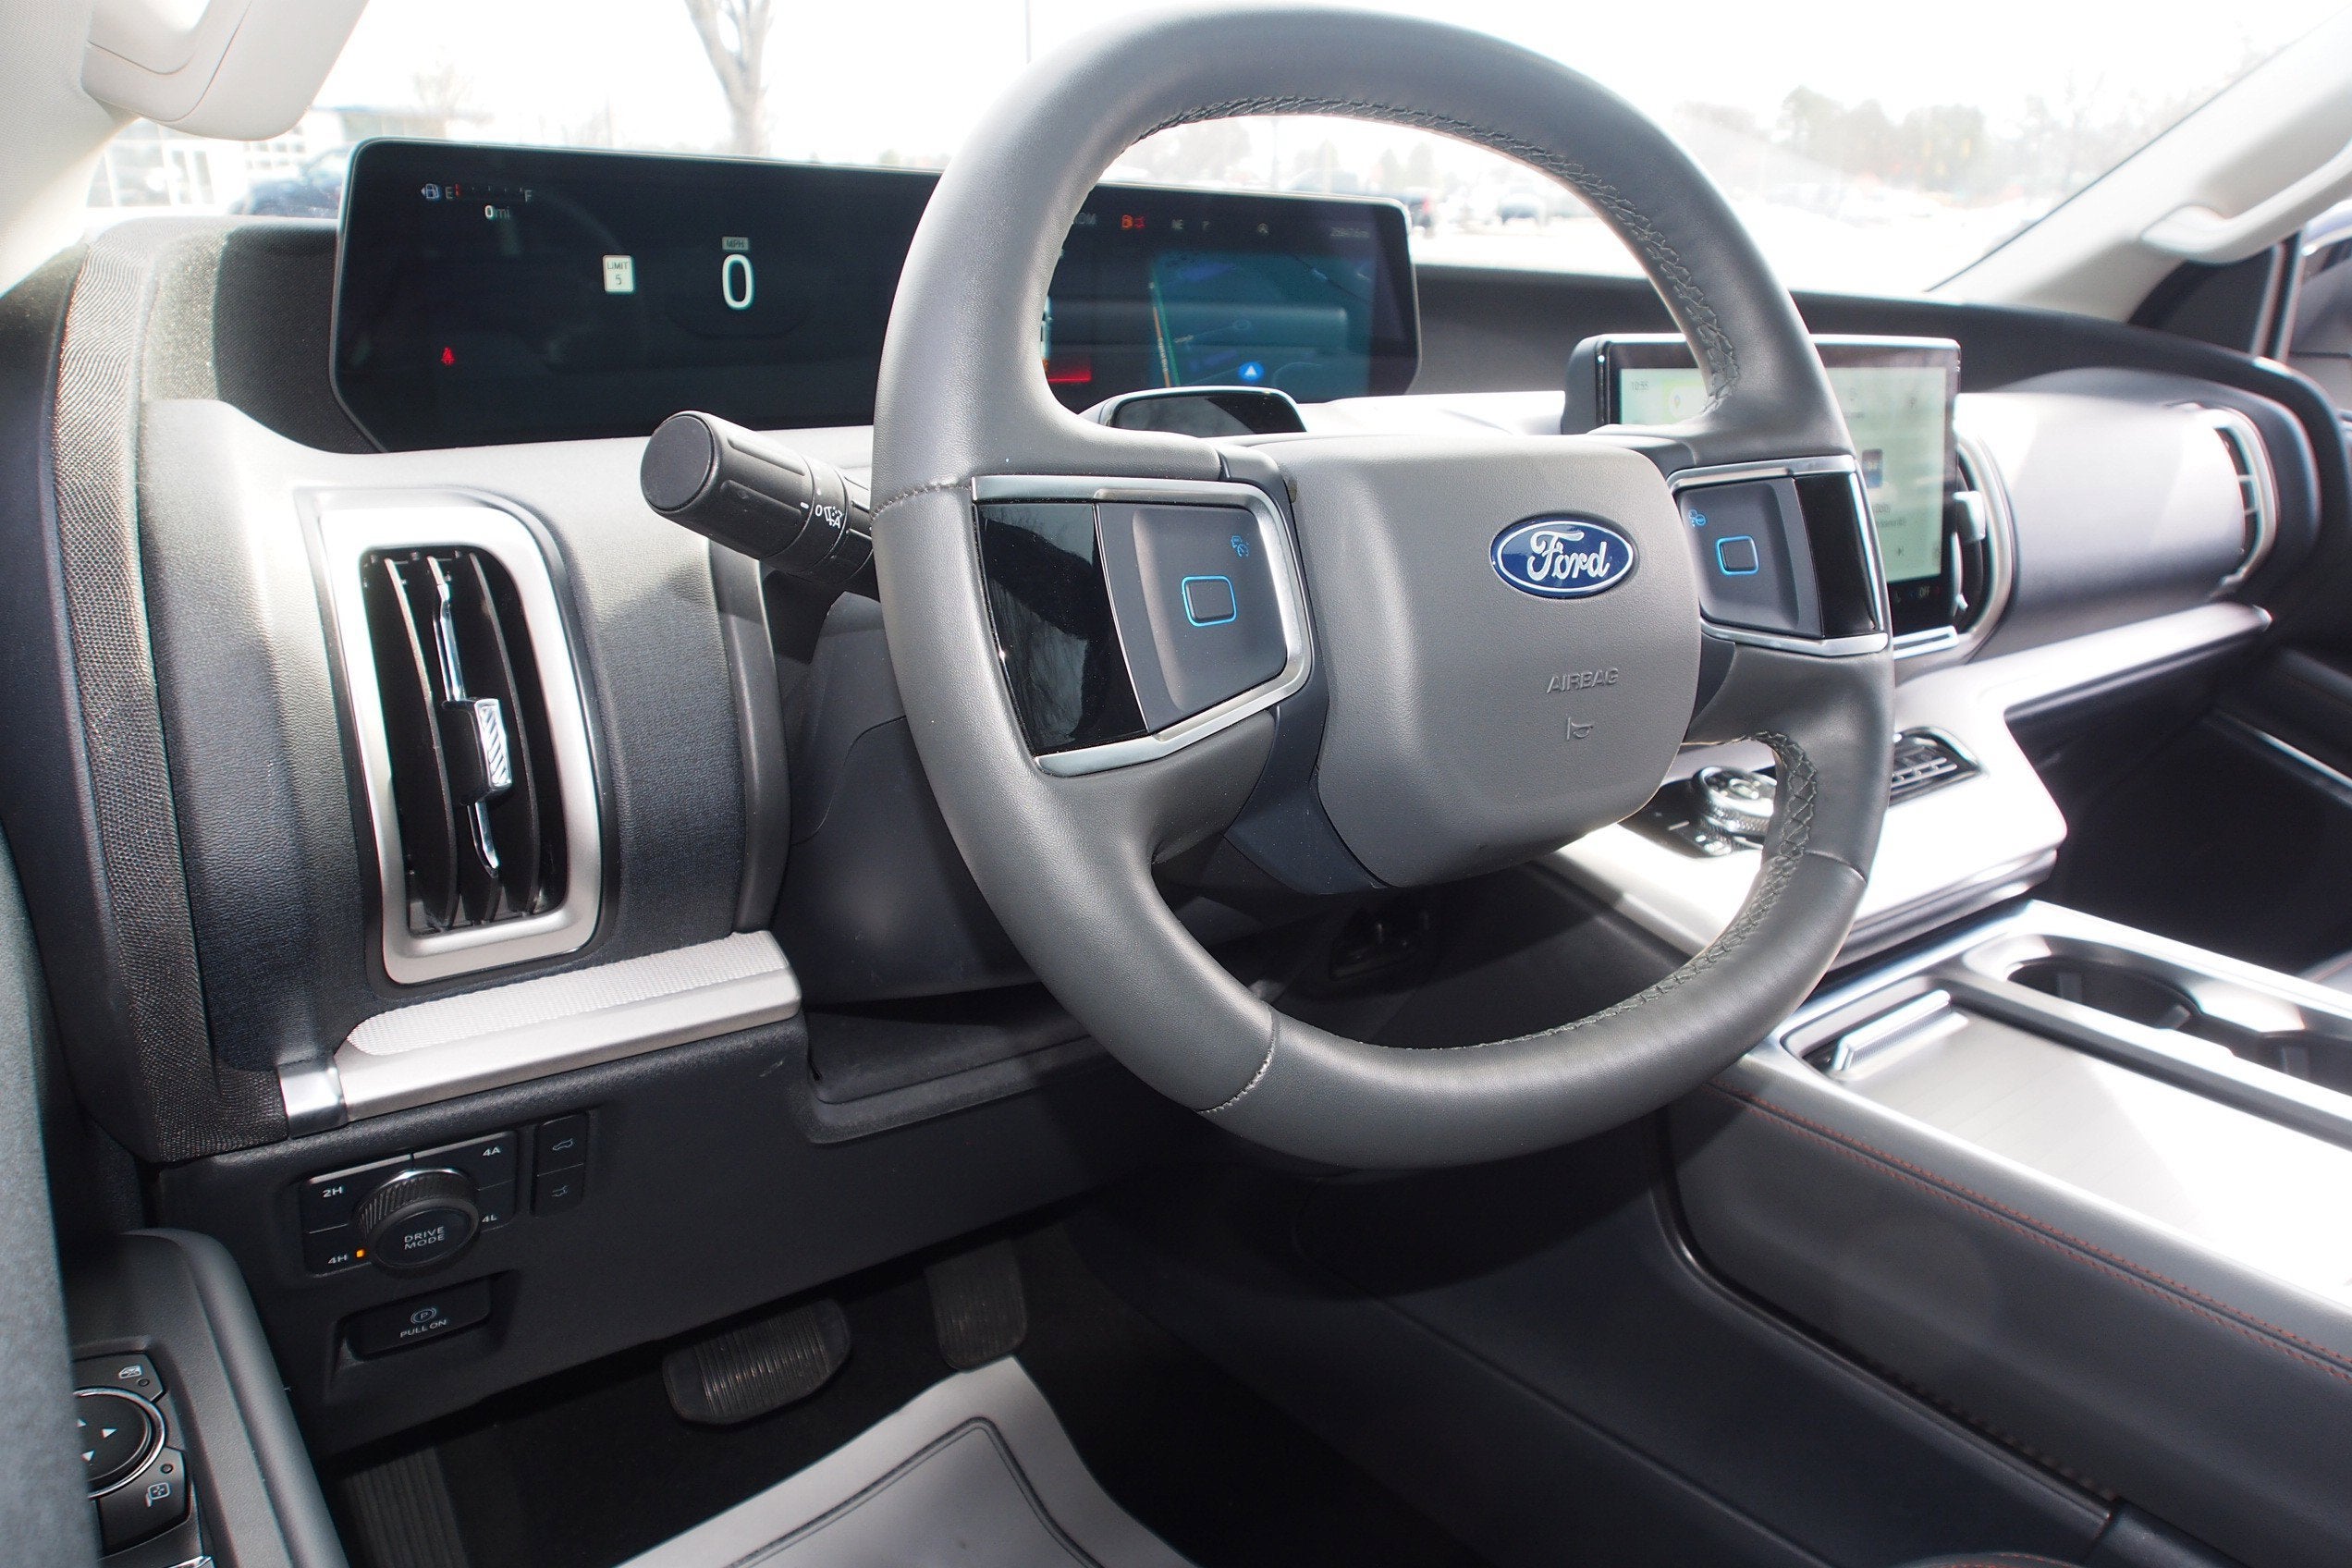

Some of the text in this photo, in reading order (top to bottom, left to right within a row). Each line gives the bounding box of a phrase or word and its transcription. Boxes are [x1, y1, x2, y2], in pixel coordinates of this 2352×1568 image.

[445, 186, 454, 200] E
[524, 190, 533, 202] F
[726, 239, 745, 249] MPH
[606, 261, 629, 270] LIMIT
[615, 274, 622, 286] 5
[722, 253, 753, 310] 0
[1526, 530, 1611, 582] Ford
[1547, 668, 1619, 694] AIRBAG
[483, 1145, 500, 1157] 4A
[323, 1186, 342, 1198] 2H
[482, 1214, 497, 1222] 4L
[404, 1226, 444, 1243] DRIVE
[404, 1234, 445, 1250] MODE
[327, 1254, 348, 1265] 4H
[399, 1319, 447, 1338] PULL ON
